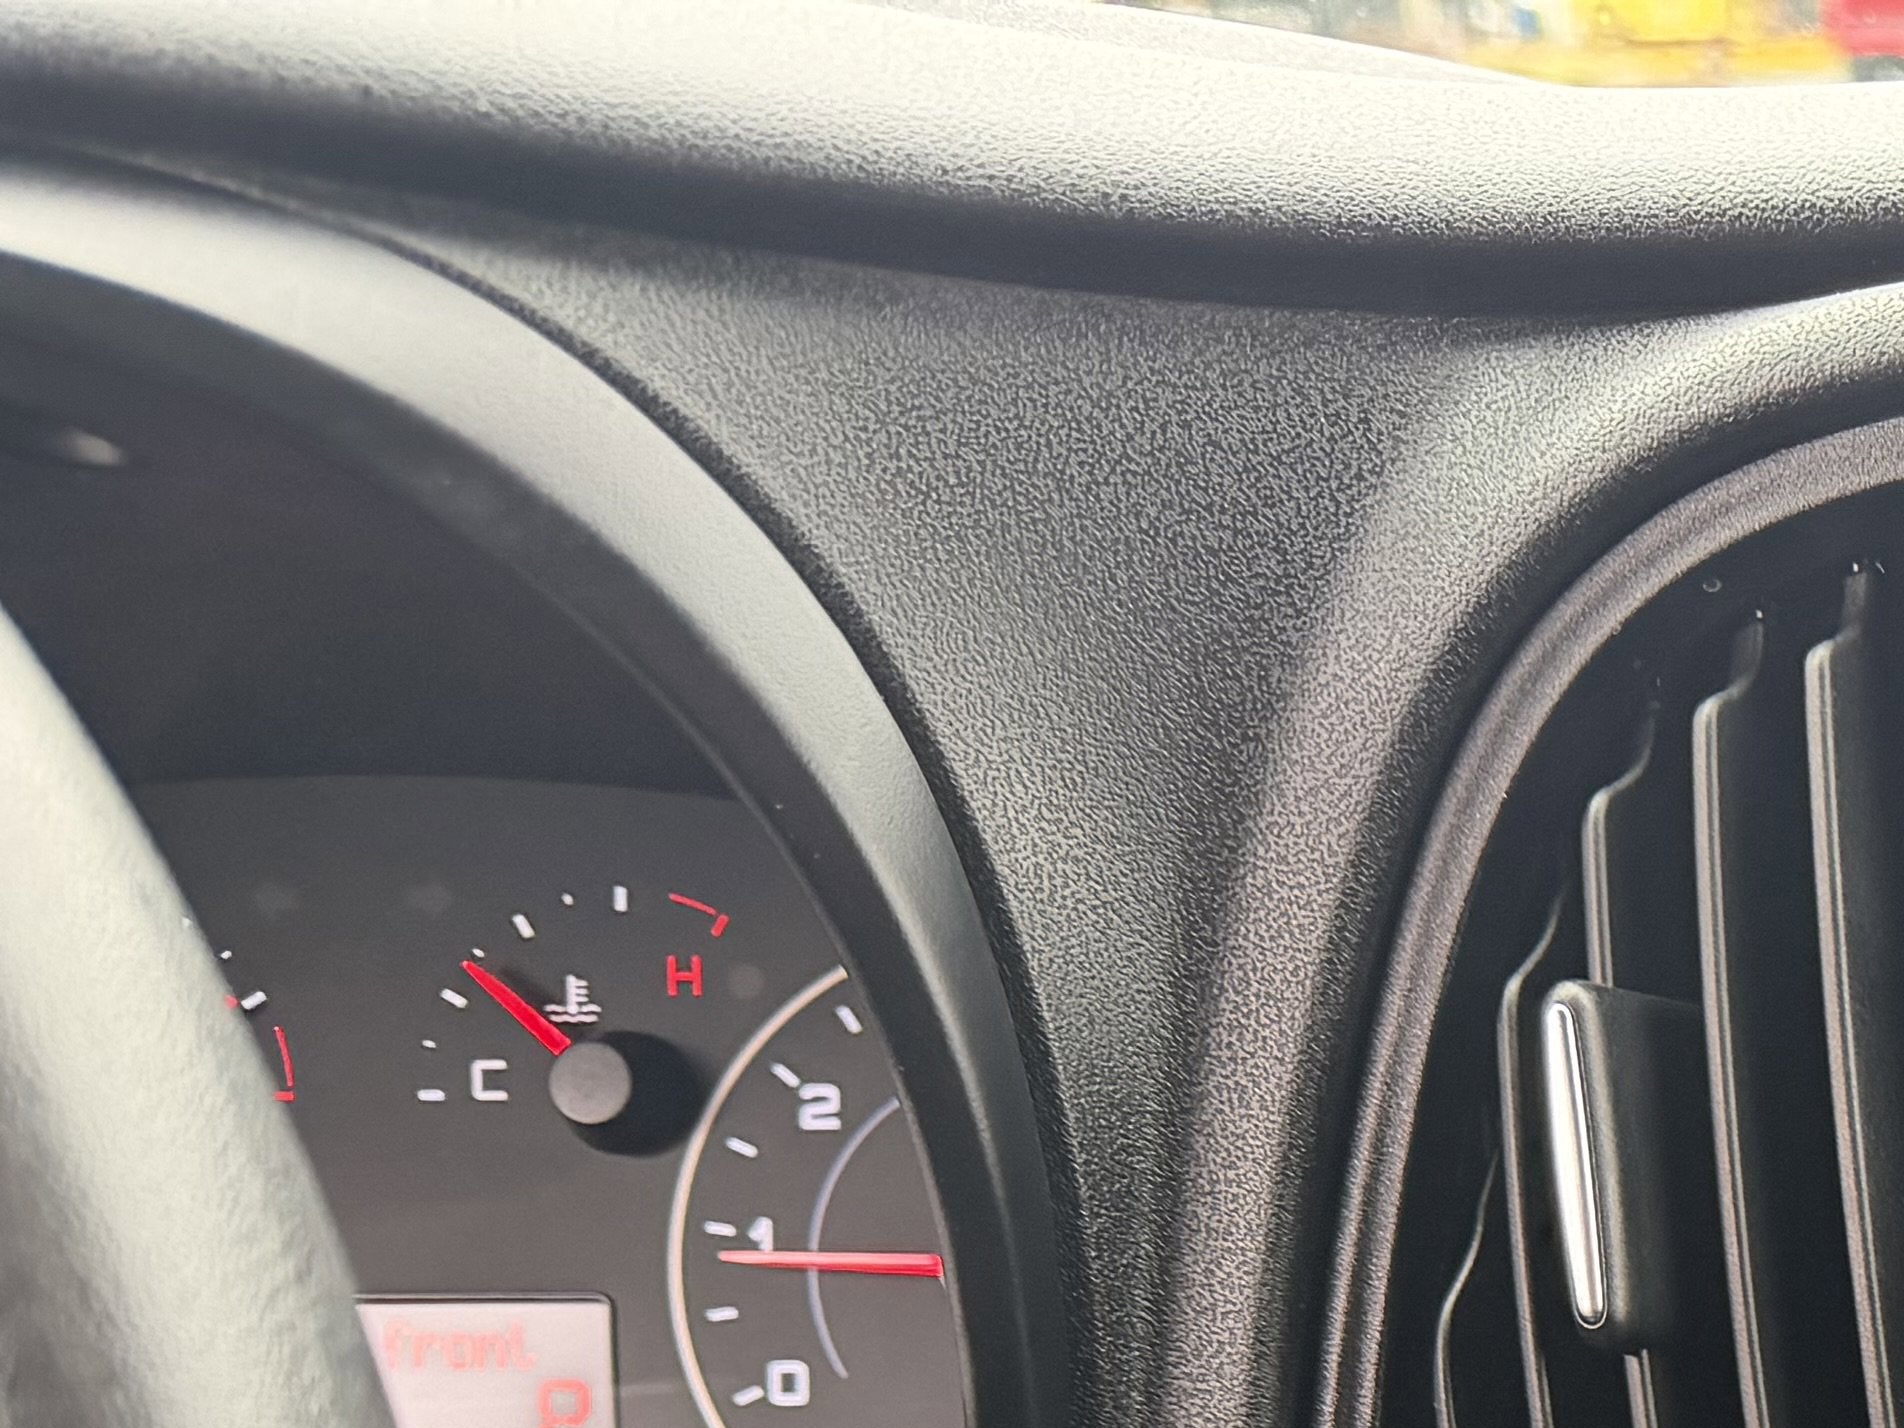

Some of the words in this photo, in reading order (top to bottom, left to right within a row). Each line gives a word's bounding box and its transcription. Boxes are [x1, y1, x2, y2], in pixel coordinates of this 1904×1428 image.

[666, 954, 703, 998] H
[470, 1059, 509, 1101] C
[799, 1082, 841, 1131] 2
[766, 1359, 810, 1407] 0
